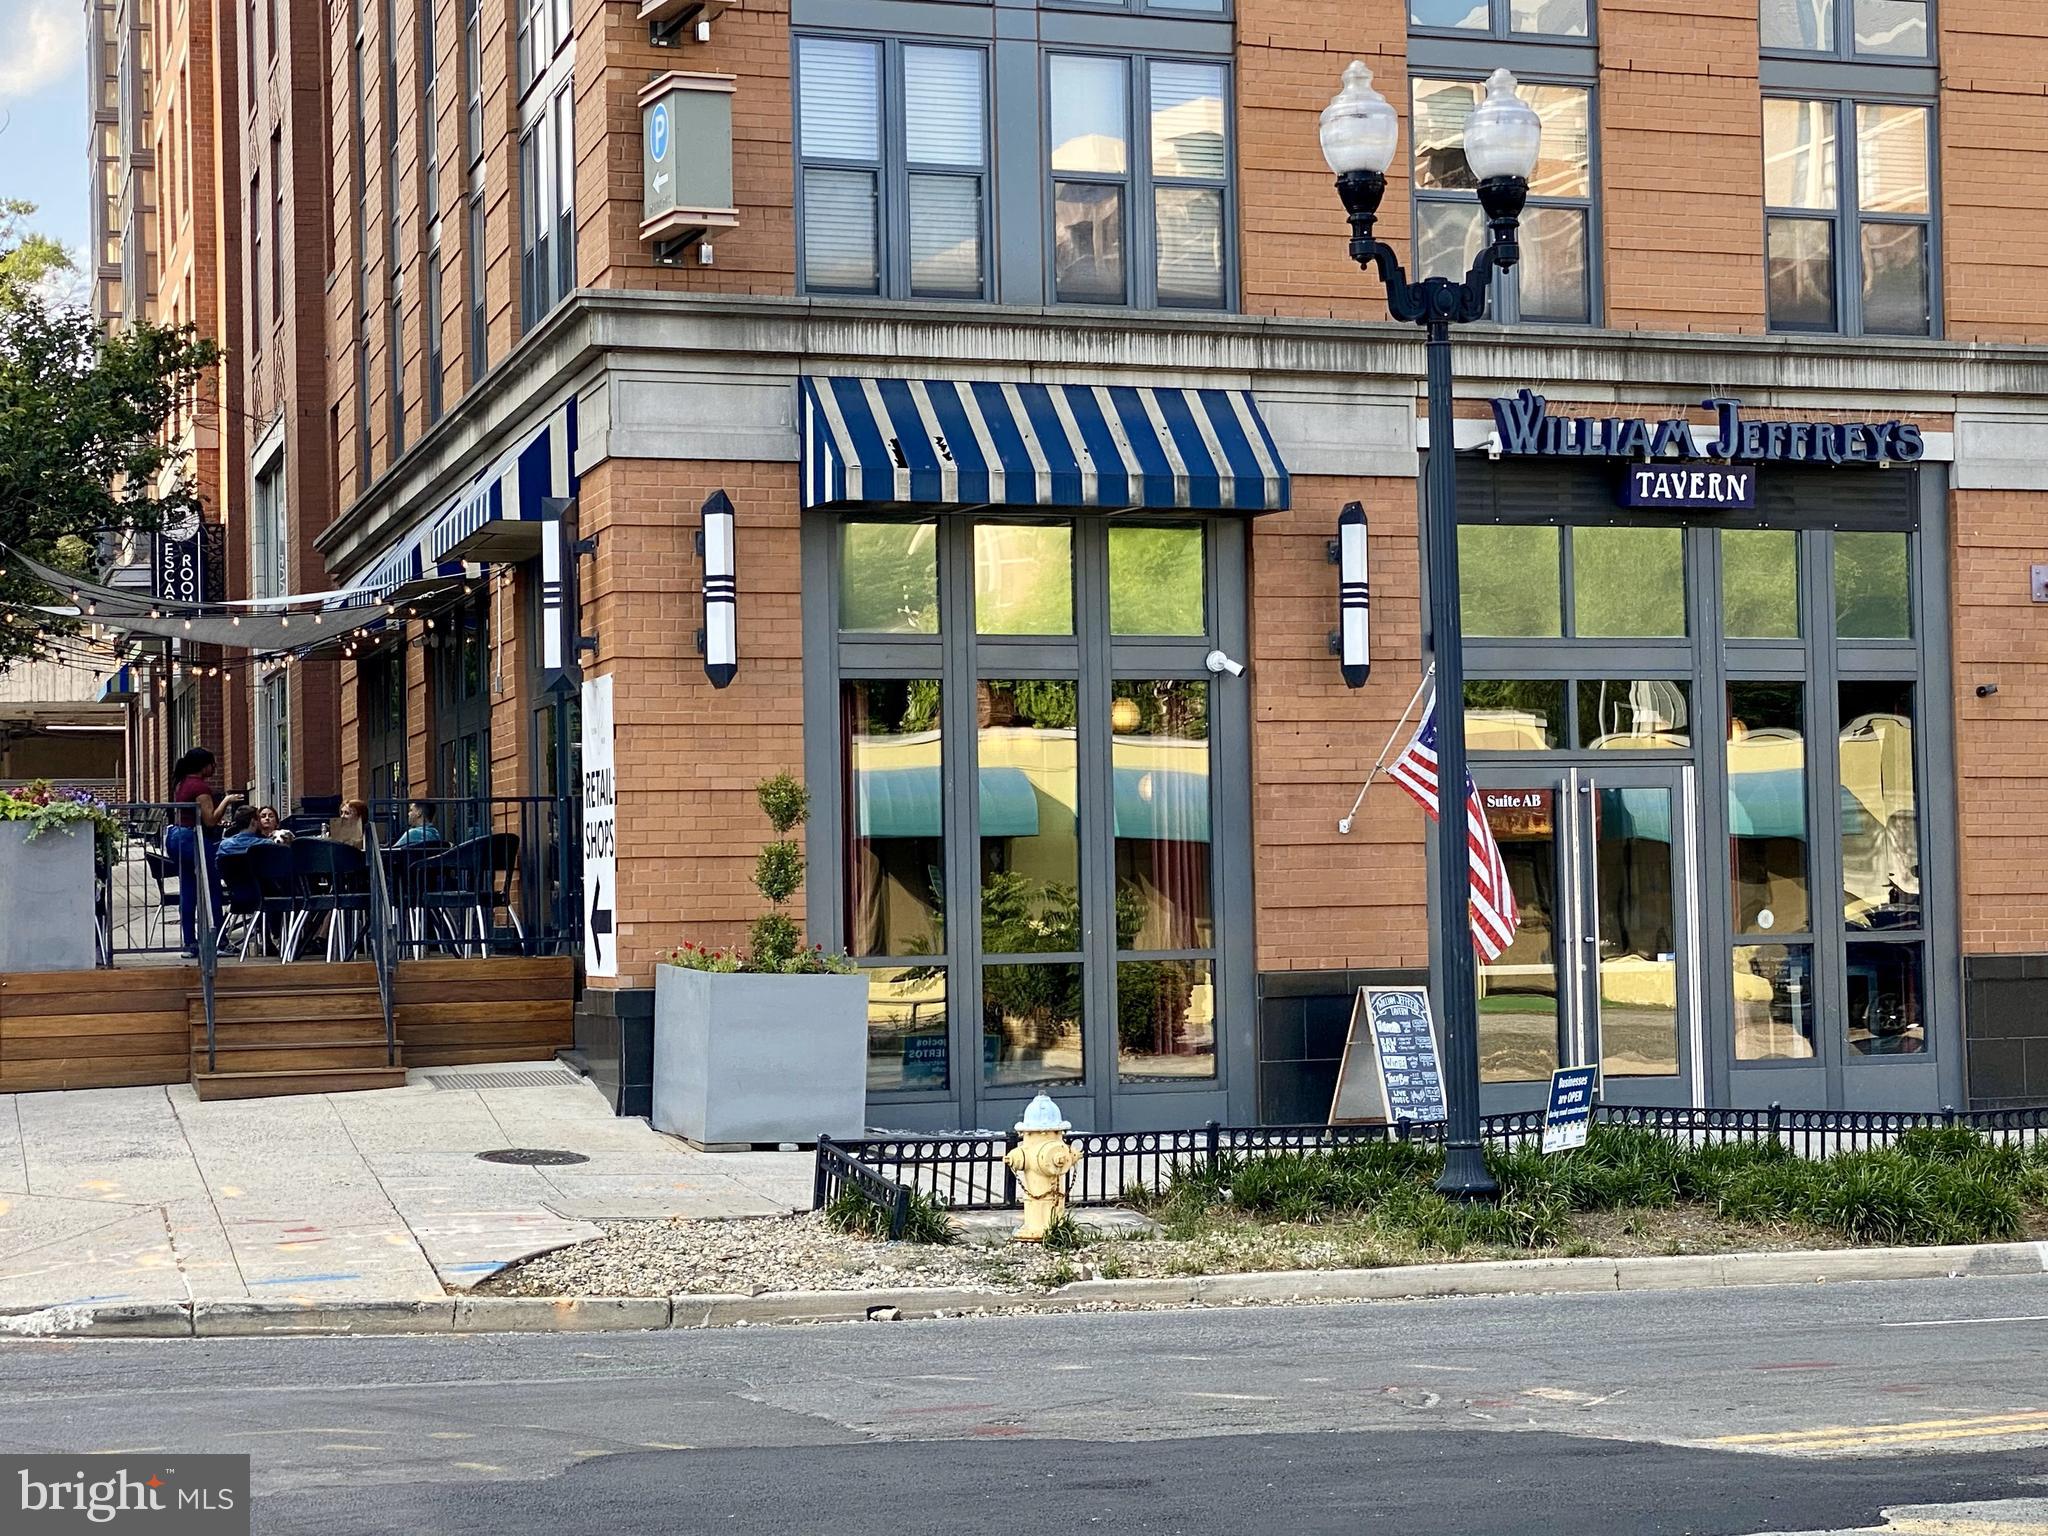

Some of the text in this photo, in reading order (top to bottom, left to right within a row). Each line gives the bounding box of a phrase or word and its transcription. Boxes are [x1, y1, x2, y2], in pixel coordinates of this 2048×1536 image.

[655, 114, 665, 153] P
[1493, 388, 1699, 459] WILLIAM
[1635, 470, 1749, 502] TAVERN
[585, 768, 614, 809] RETAIL
[1487, 794, 1541, 808] Suite AB
[585, 818, 614, 860] SHOPS
[1558, 1075, 1588, 1089] Businesses
[1558, 1090, 1583, 1105] are OPEN
[1568, 1105, 1589, 1115] construction
